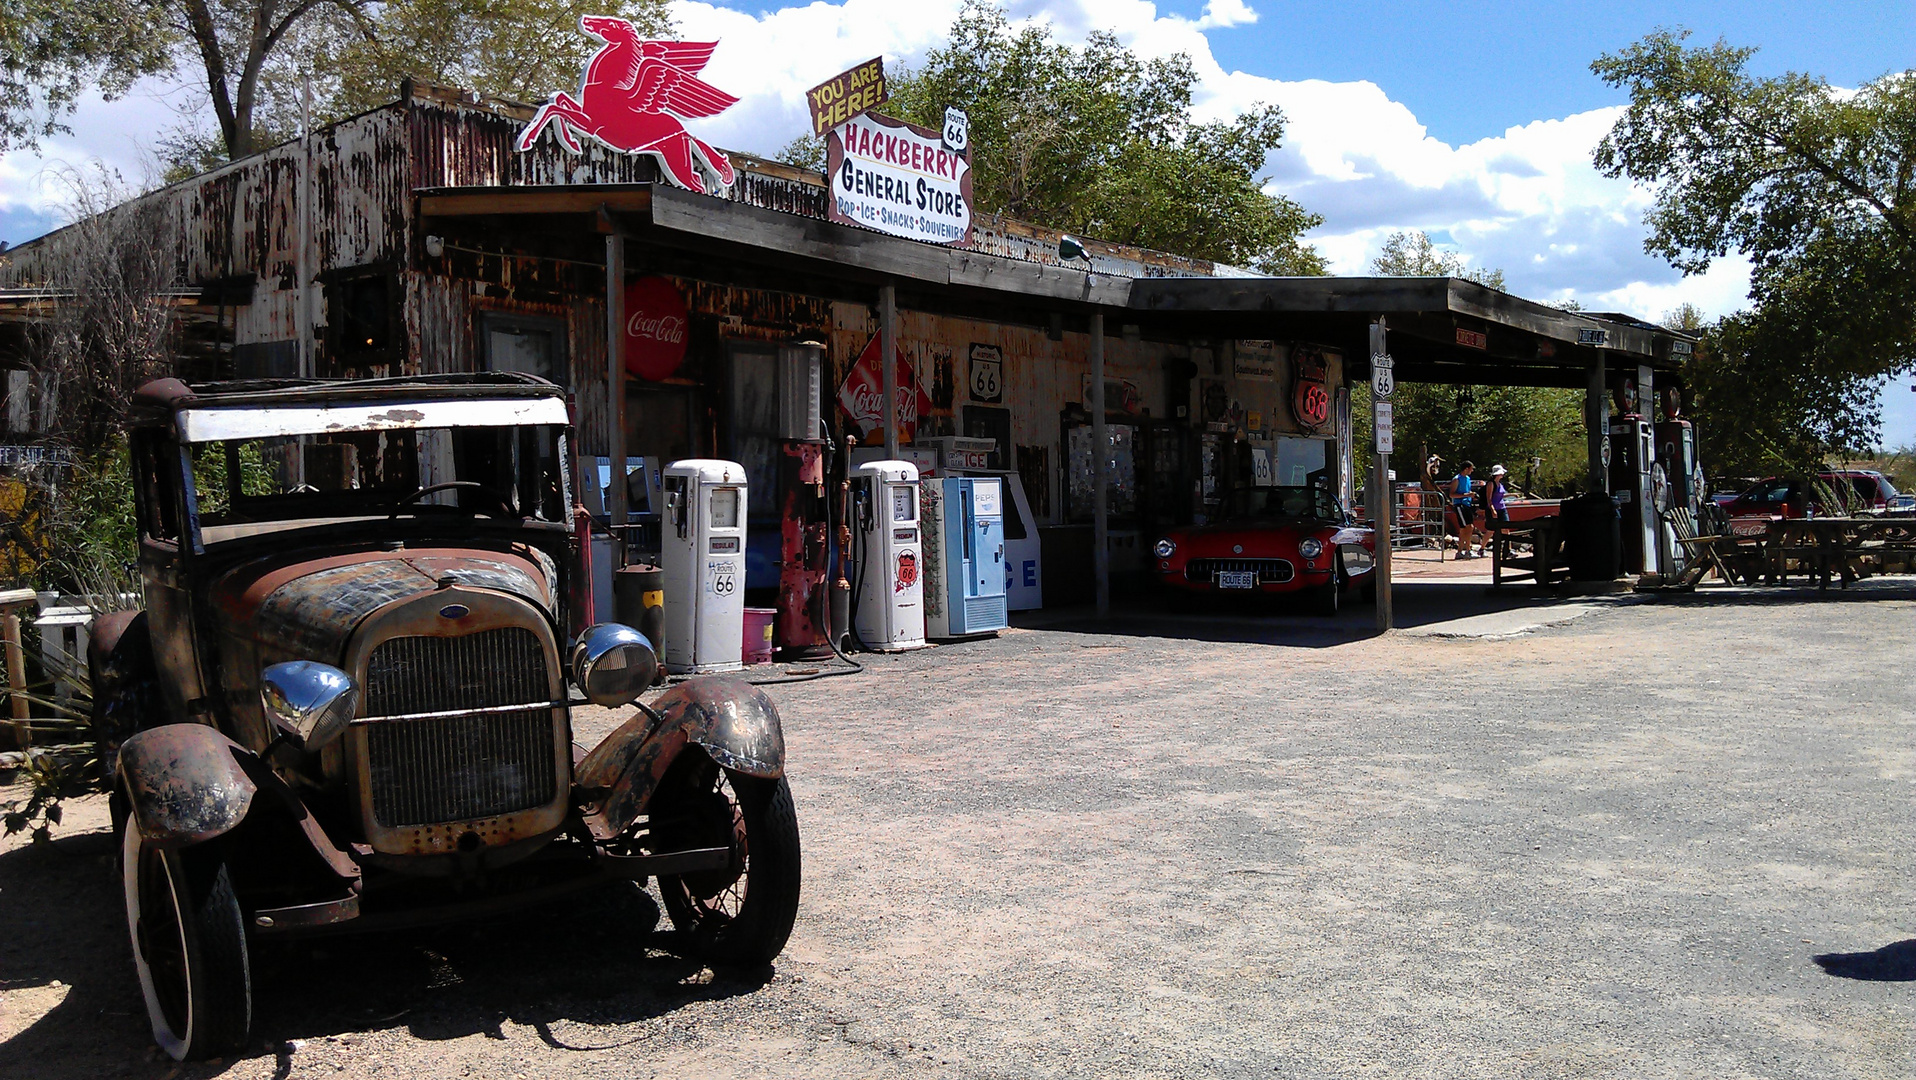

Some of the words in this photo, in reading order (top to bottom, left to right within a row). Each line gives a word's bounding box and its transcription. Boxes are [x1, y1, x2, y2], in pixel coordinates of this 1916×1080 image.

[812, 79, 844, 107] YOU
[850, 63, 880, 92] ARE
[817, 81, 884, 133] HERE!
[947, 112, 965, 126] ROUTE
[947, 125, 964, 144] 66
[845, 124, 958, 180] HACKBERRY
[842, 158, 912, 206] GENERAL
[916, 177, 962, 218] STORE
[976, 351, 996, 360] HISTORIC
[1376, 358, 1390, 366] ROUTE
[976, 371, 996, 392] 66
[1378, 378, 1389, 392] 66
[965, 453, 985, 468] ICE
[1256, 459, 1268, 478] 66
[902, 568, 913, 580] 66
[1222, 576, 1241, 584] ROUTE
[716, 576, 733, 592] 66
